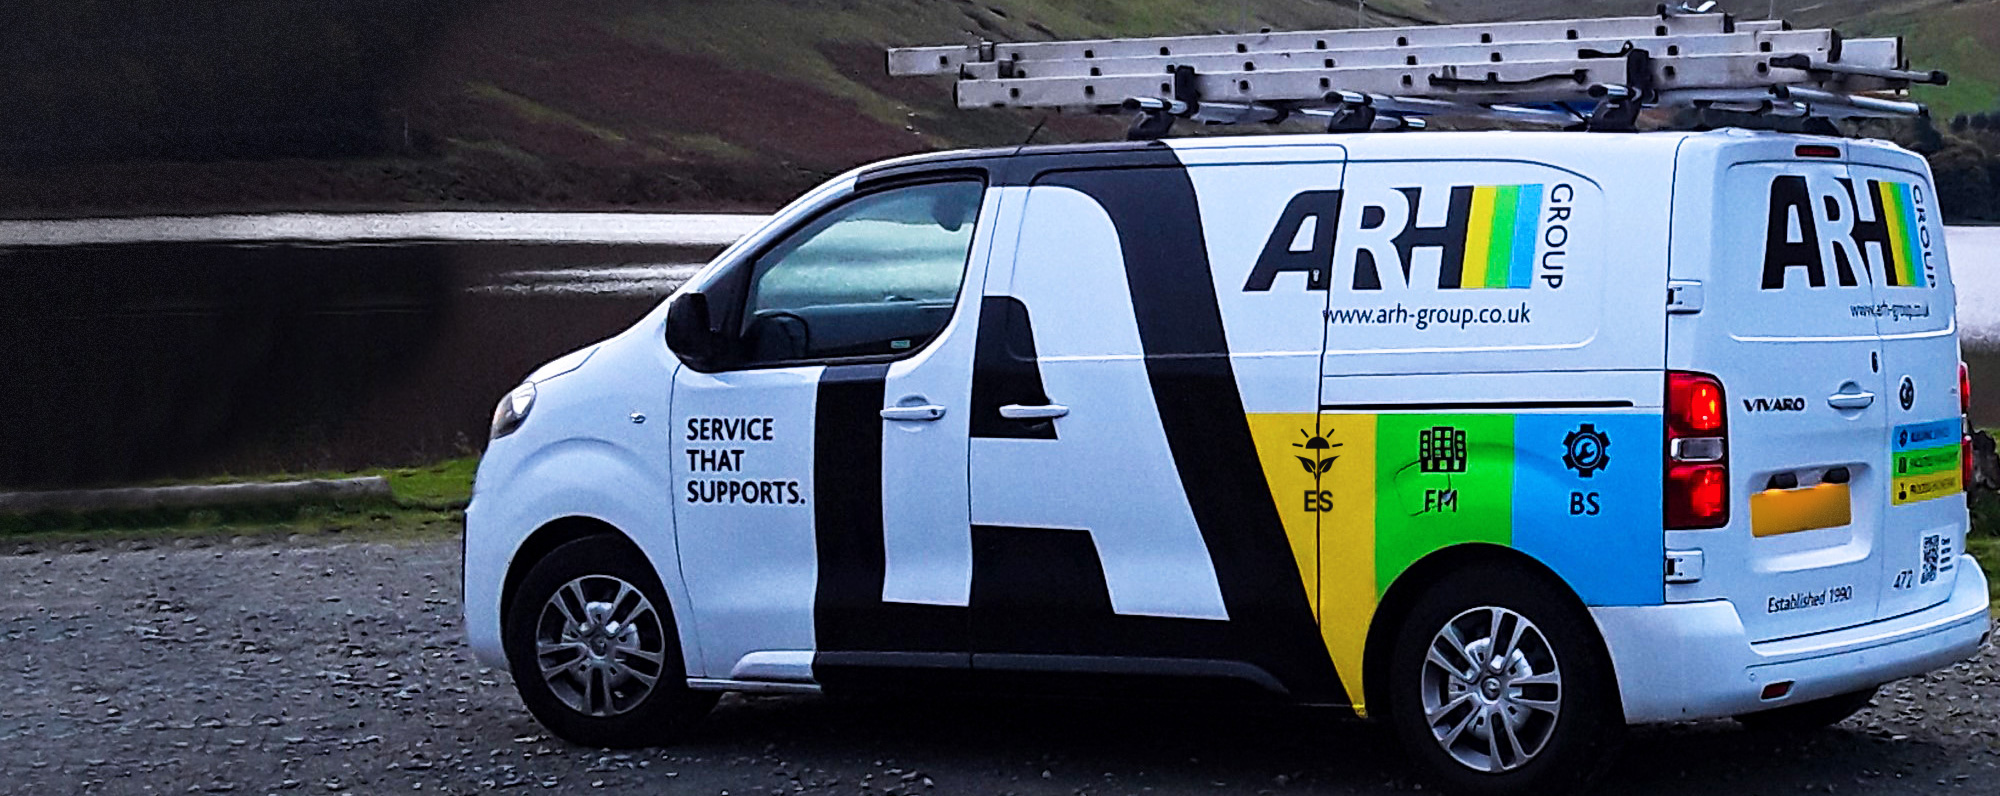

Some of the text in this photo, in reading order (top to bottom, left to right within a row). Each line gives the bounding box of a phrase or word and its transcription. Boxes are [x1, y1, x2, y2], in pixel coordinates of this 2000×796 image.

[1242, 185, 1475, 291] ARH
[1540, 183, 1574, 289] GROUP
[1761, 175, 1899, 290] ARH
[1322, 302, 1531, 329] www.arh-group.co.uk
[1743, 397, 1805, 412] VIVARO
[686, 418, 774, 441] SERVICE
[686, 449, 745, 472] THAT
[687, 480, 806, 505] SUPPORTS.
[1303, 490, 1334, 513] ES
[1424, 489, 1458, 513] FM
[1569, 492, 1601, 516] BS
[1767, 585, 1852, 613] Established 1990
